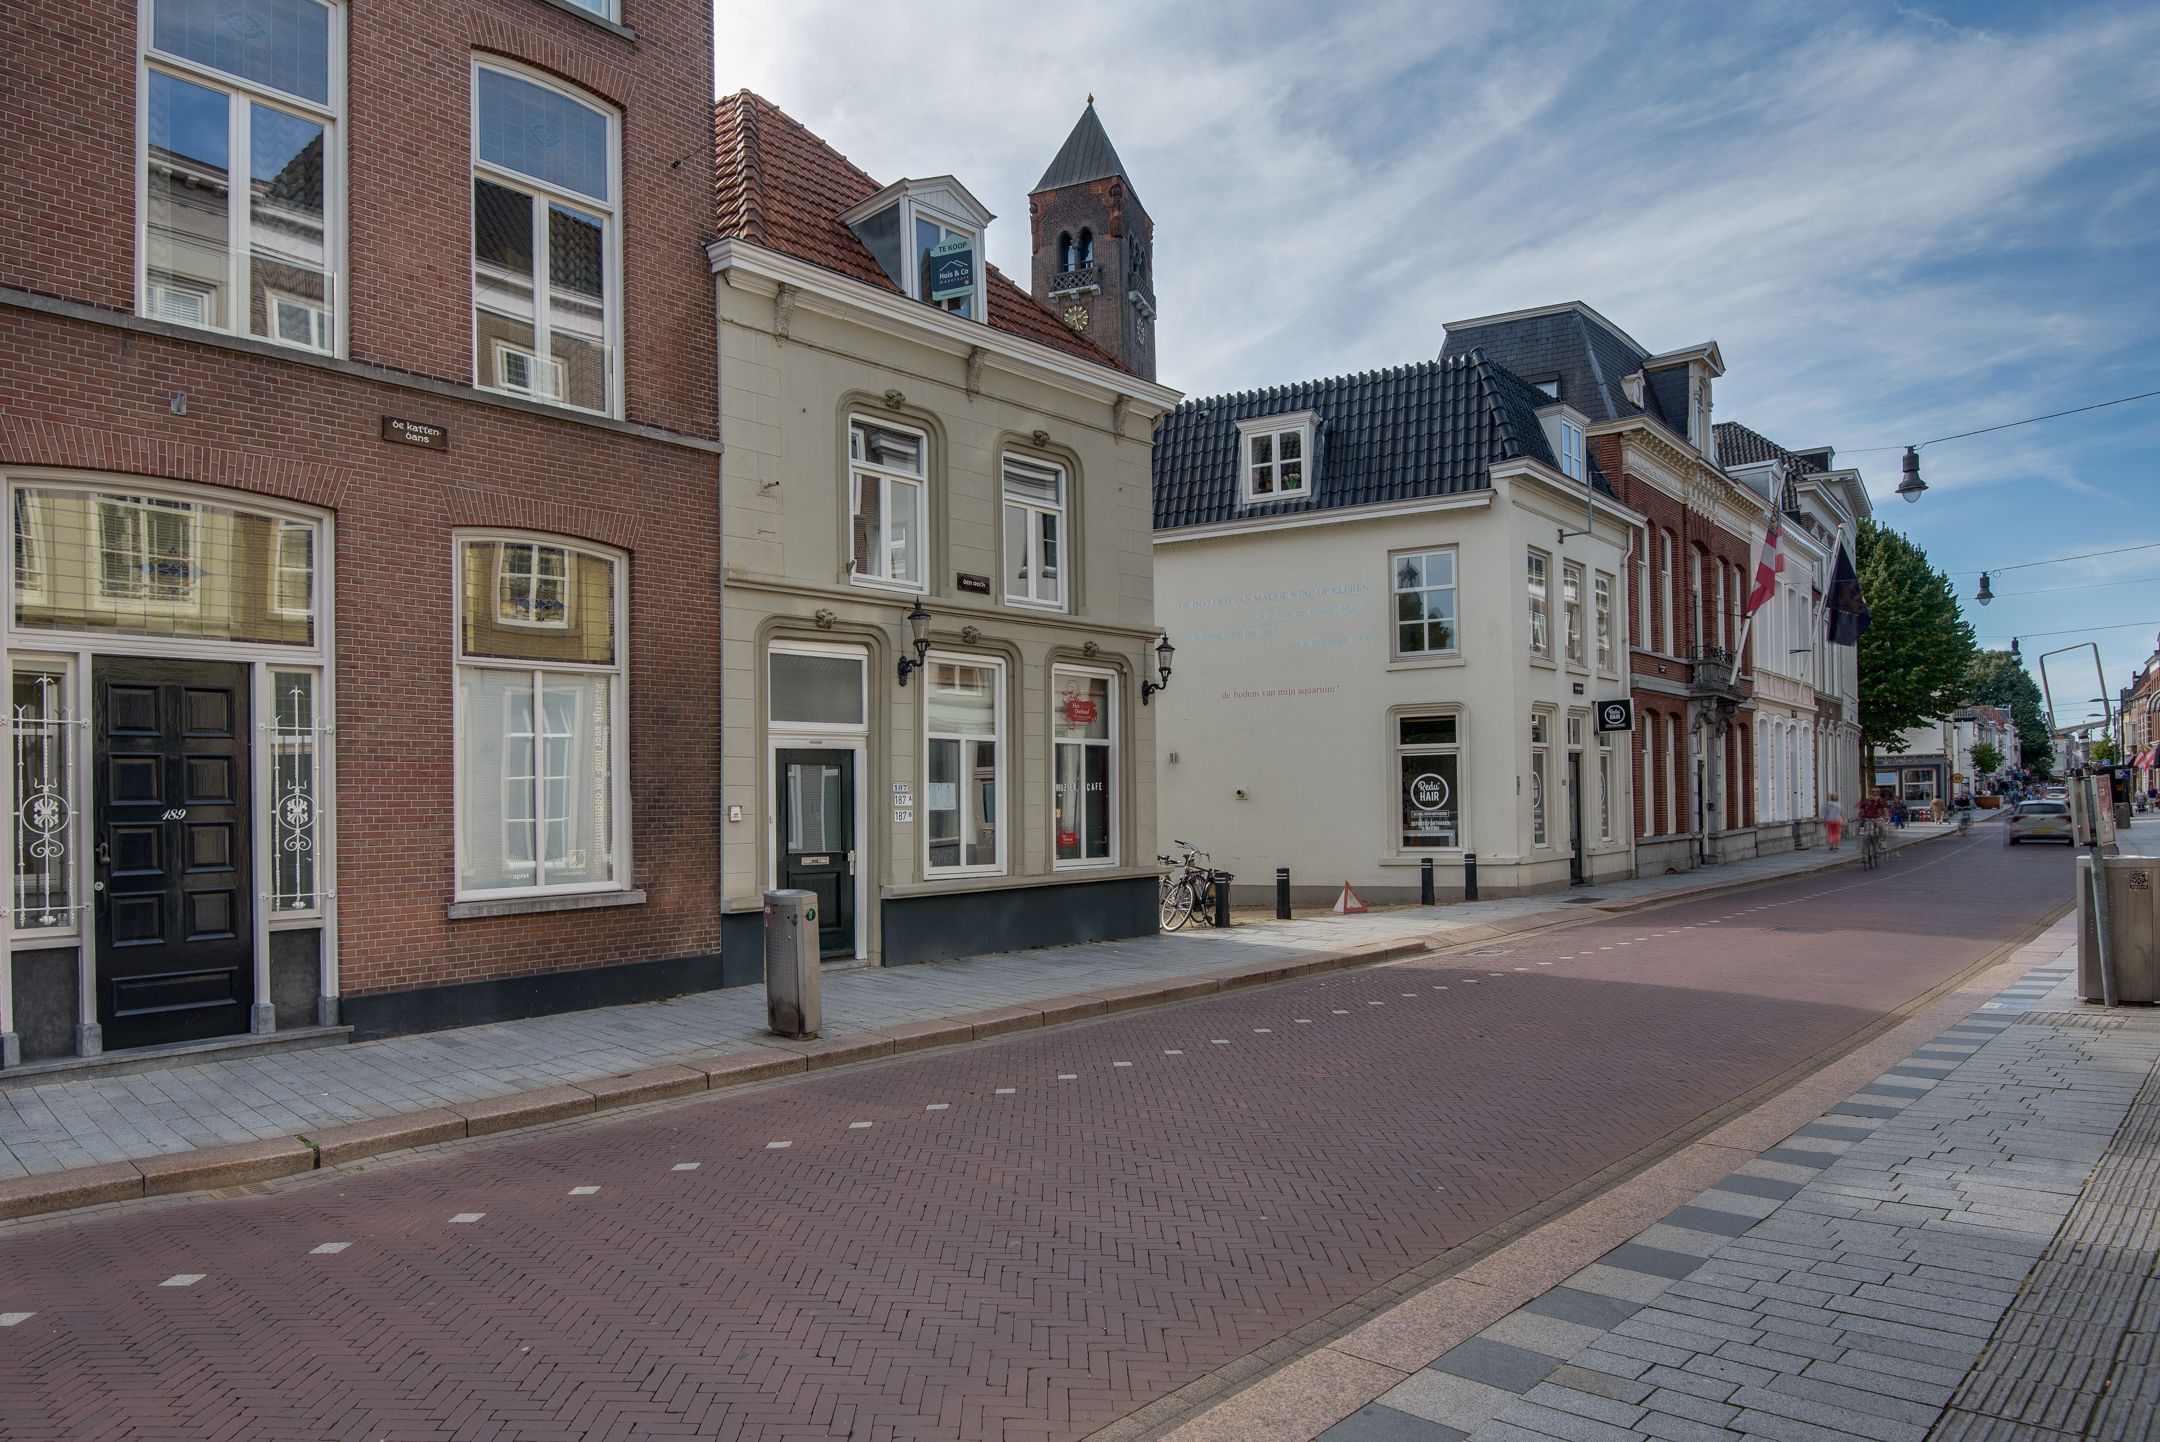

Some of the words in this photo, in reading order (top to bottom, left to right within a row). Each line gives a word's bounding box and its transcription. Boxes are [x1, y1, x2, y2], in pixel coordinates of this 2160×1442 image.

[947, 241, 967, 251] KOOP
[939, 270, 953, 280] Huis
[392, 420, 405, 429] de
[405, 431, 429, 443] dans
[1179, 601, 1191, 610] DE
[1233, 594, 1252, 604] VAN
[1290, 588, 1316, 598] WIND
[1317, 587, 1330, 596] OP
[1331, 584, 1370, 596] KLEREN
[1222, 690, 1231, 700] de
[1233, 688, 1260, 699] bodem
[1262, 689, 1276, 697] van
[1278, 686, 1296, 697] mijn
[1297, 684, 1340, 696] aquarium?
[594, 726, 604, 747] voor
[1086, 782, 1103, 792] CAFE
[895, 795, 906, 805] 187
[1420, 791, 1439, 801] HAIR
[161, 808, 186, 820] 189
[895, 811, 907, 821] 187
